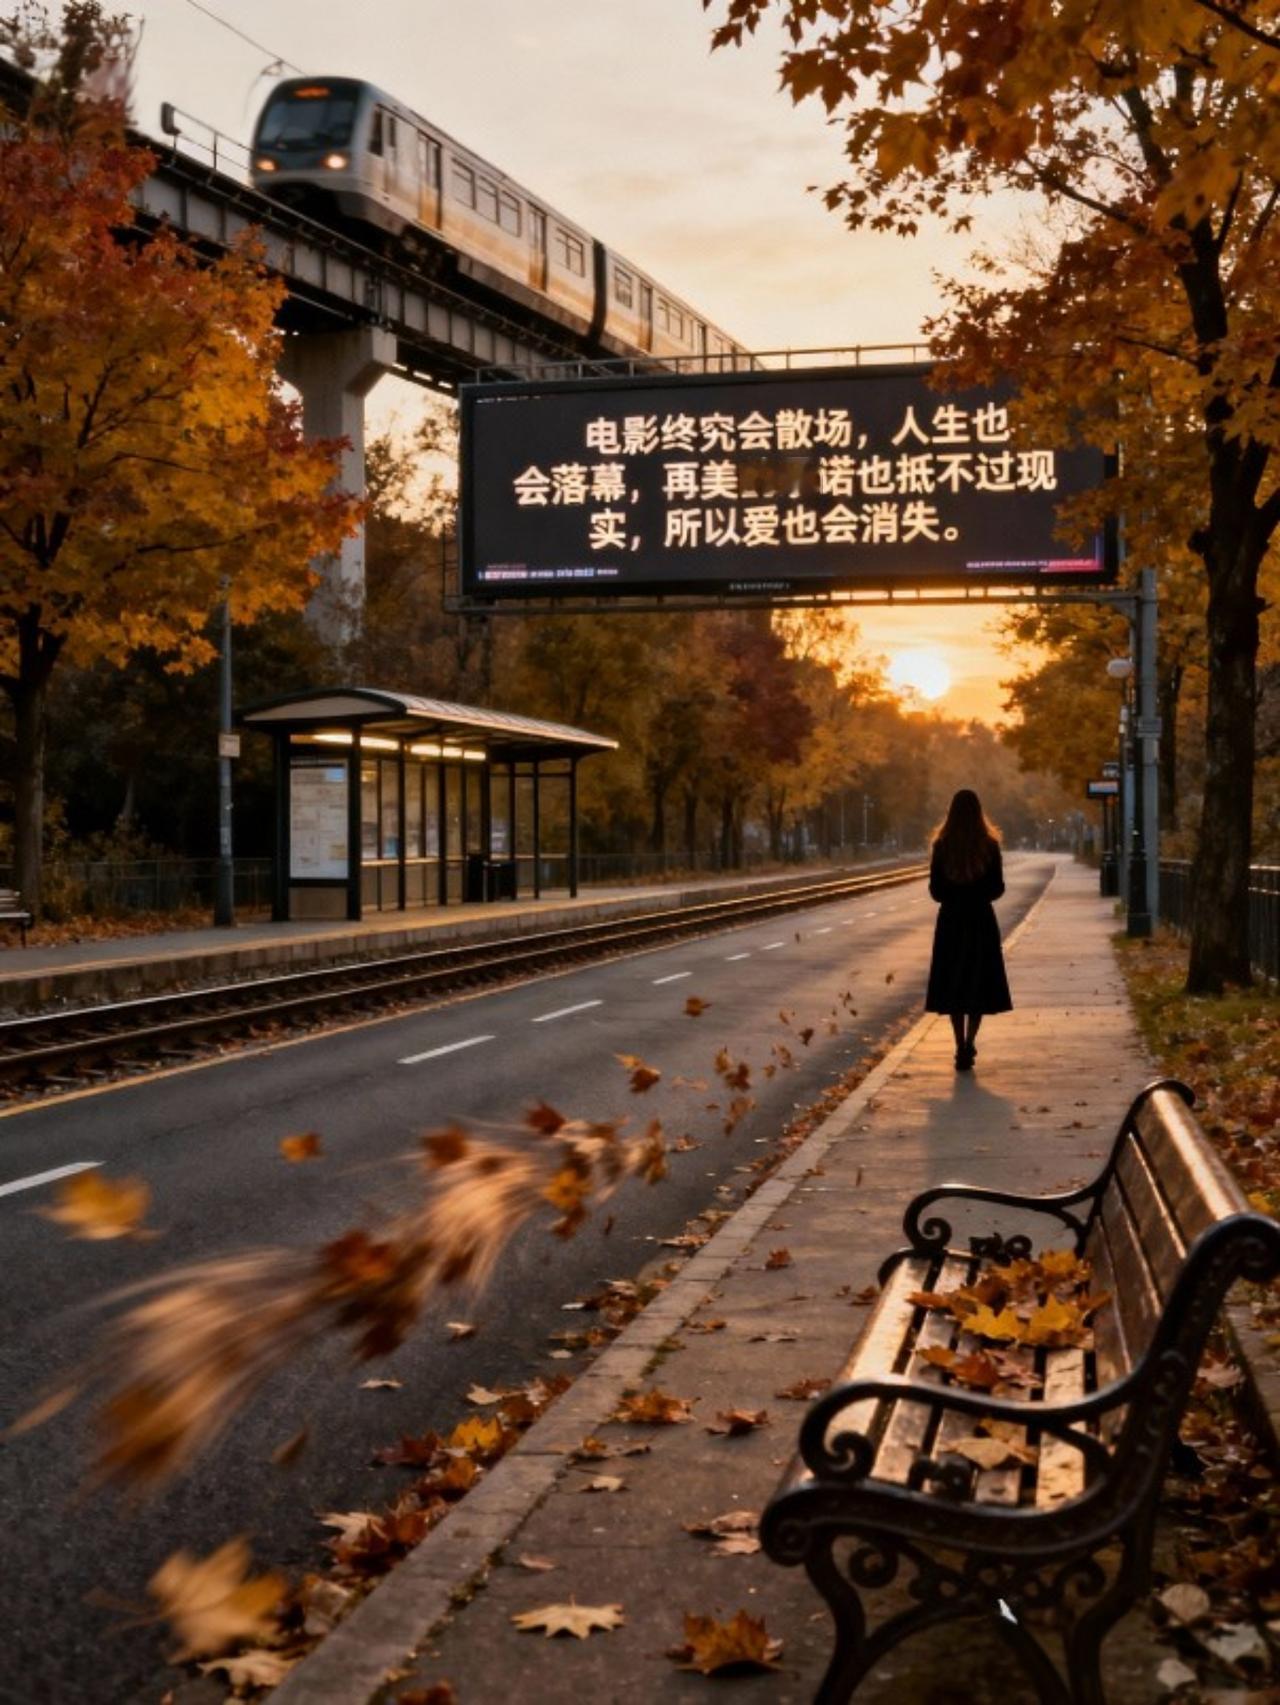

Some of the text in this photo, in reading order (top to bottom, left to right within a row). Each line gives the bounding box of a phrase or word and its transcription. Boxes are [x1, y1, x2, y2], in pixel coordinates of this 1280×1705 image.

[586, 402, 1015, 455] 电影终究会散场，人生也
[513, 450, 1057, 506] 会落幕，再美诺也抵不过现
[589, 500, 958, 551] 实，所以爱也会消失。
